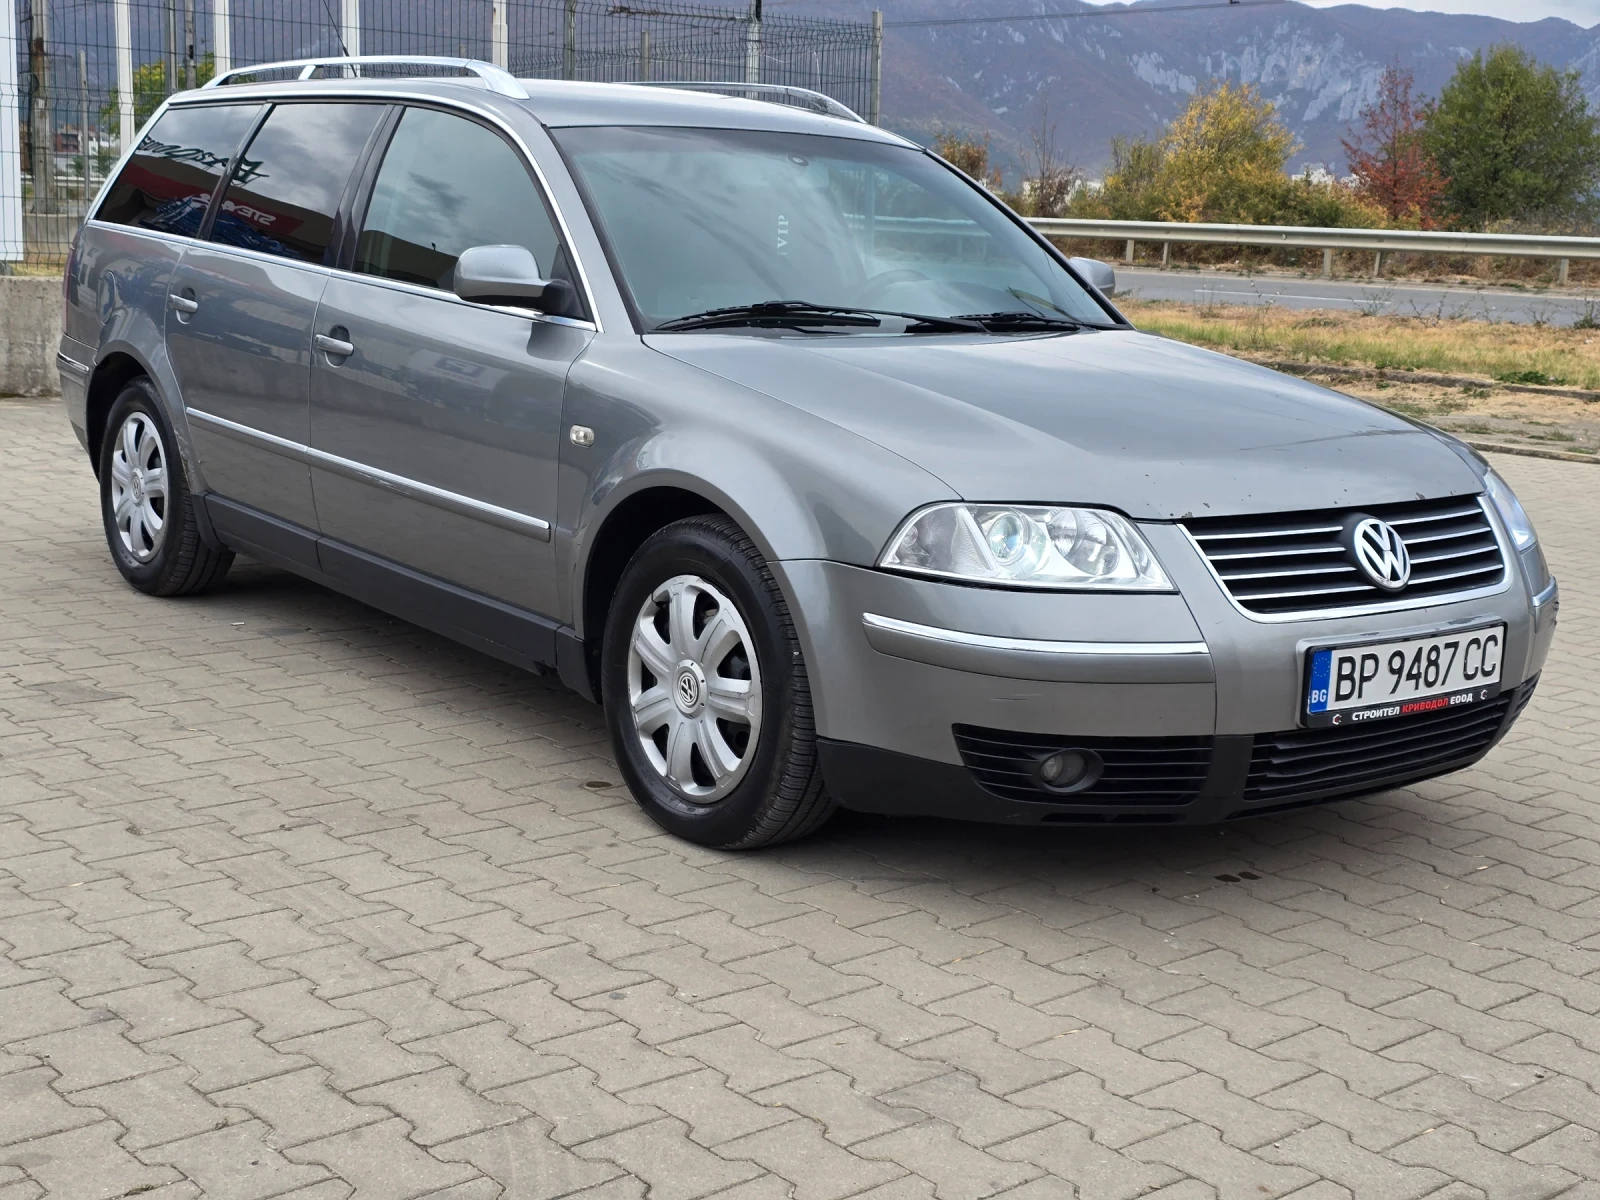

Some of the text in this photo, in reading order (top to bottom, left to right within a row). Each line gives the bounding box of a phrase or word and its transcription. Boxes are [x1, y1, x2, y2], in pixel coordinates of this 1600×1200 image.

[777, 214, 789, 249] VIP
[1311, 689, 1327, 704] BG
[1352, 693, 1473, 721] СТРОИТЕЛ КРИВОДОЛ ЕООД
